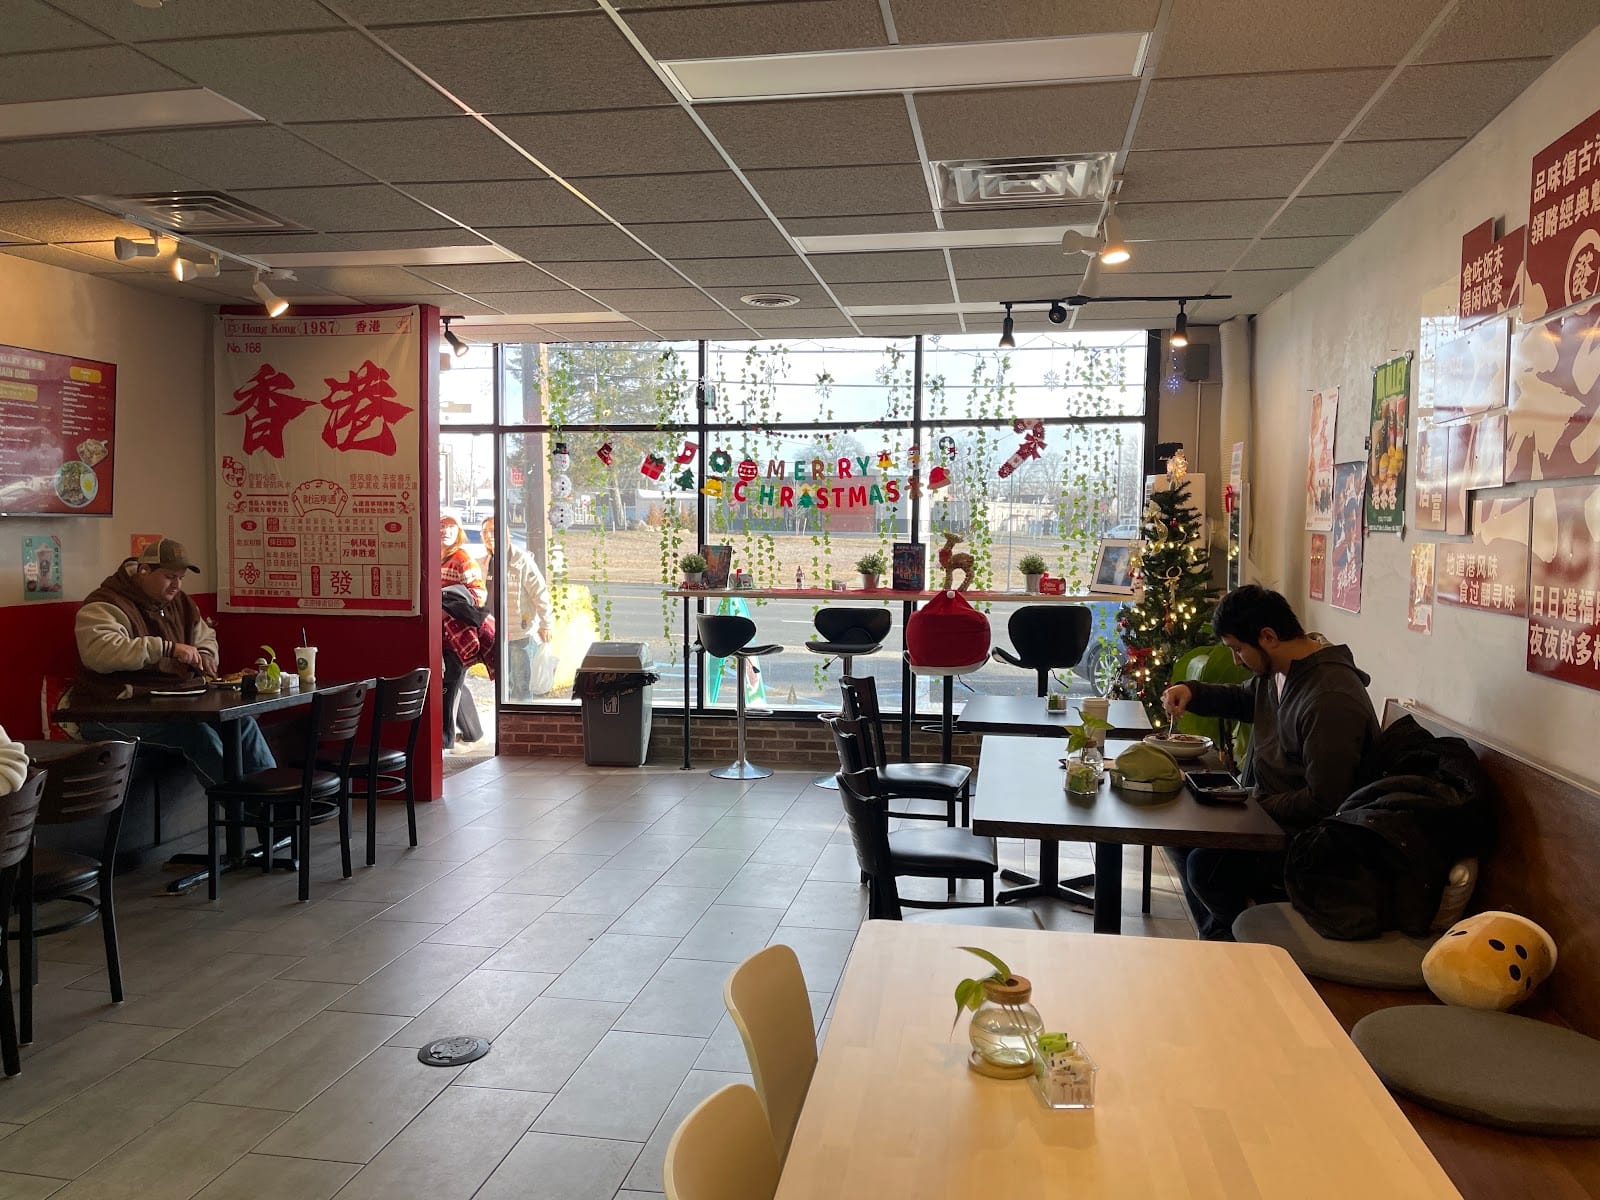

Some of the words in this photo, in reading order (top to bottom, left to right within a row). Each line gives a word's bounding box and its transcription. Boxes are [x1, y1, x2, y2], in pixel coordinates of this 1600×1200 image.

[242, 322, 267, 335] Hong
[272, 322, 297, 335] Kong
[355, 319, 381, 333] 香港
[223, 360, 415, 459] 香港
[766, 456, 871, 481] MERRY
[734, 480, 901, 509] CHRSTMAS
[330, 570, 352, 595] 發
